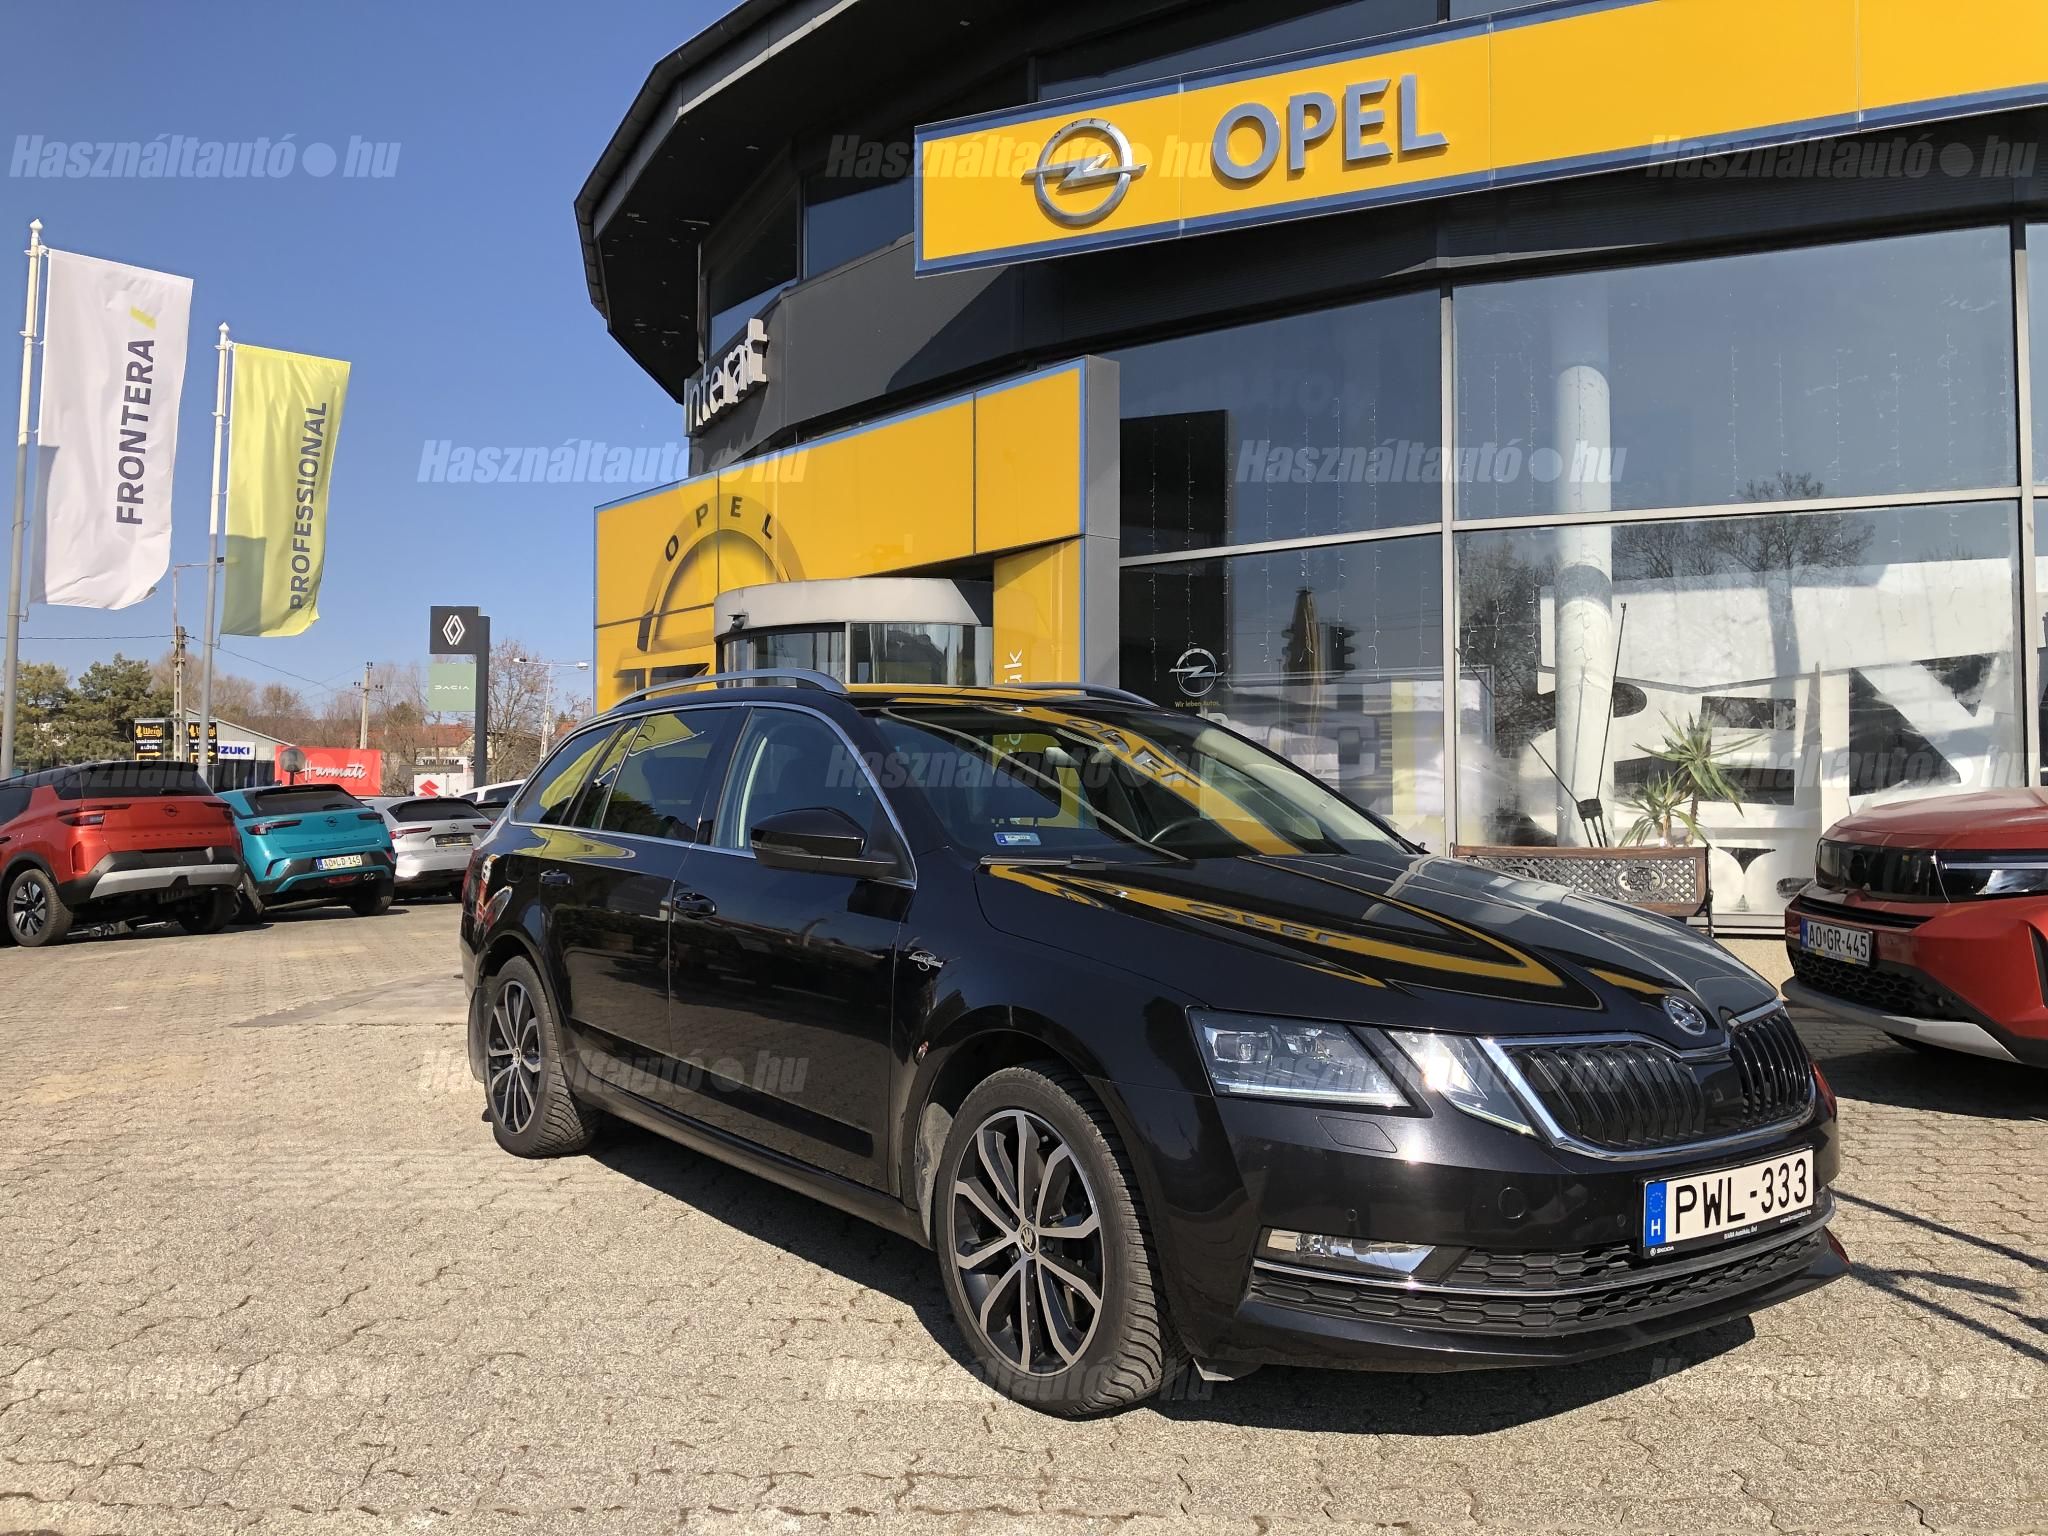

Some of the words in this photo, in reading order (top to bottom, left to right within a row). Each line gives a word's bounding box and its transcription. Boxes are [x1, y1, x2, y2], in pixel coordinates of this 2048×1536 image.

[1212, 73, 1449, 181] OPEL
[116, 340, 154, 525] FRONTERA
[290, 403, 327, 609] PROFESSIONAL
[665, 496, 773, 562] OPEL
[1651, 1218, 1661, 1237] H
[1675, 1158, 1807, 1234] PWL-333
